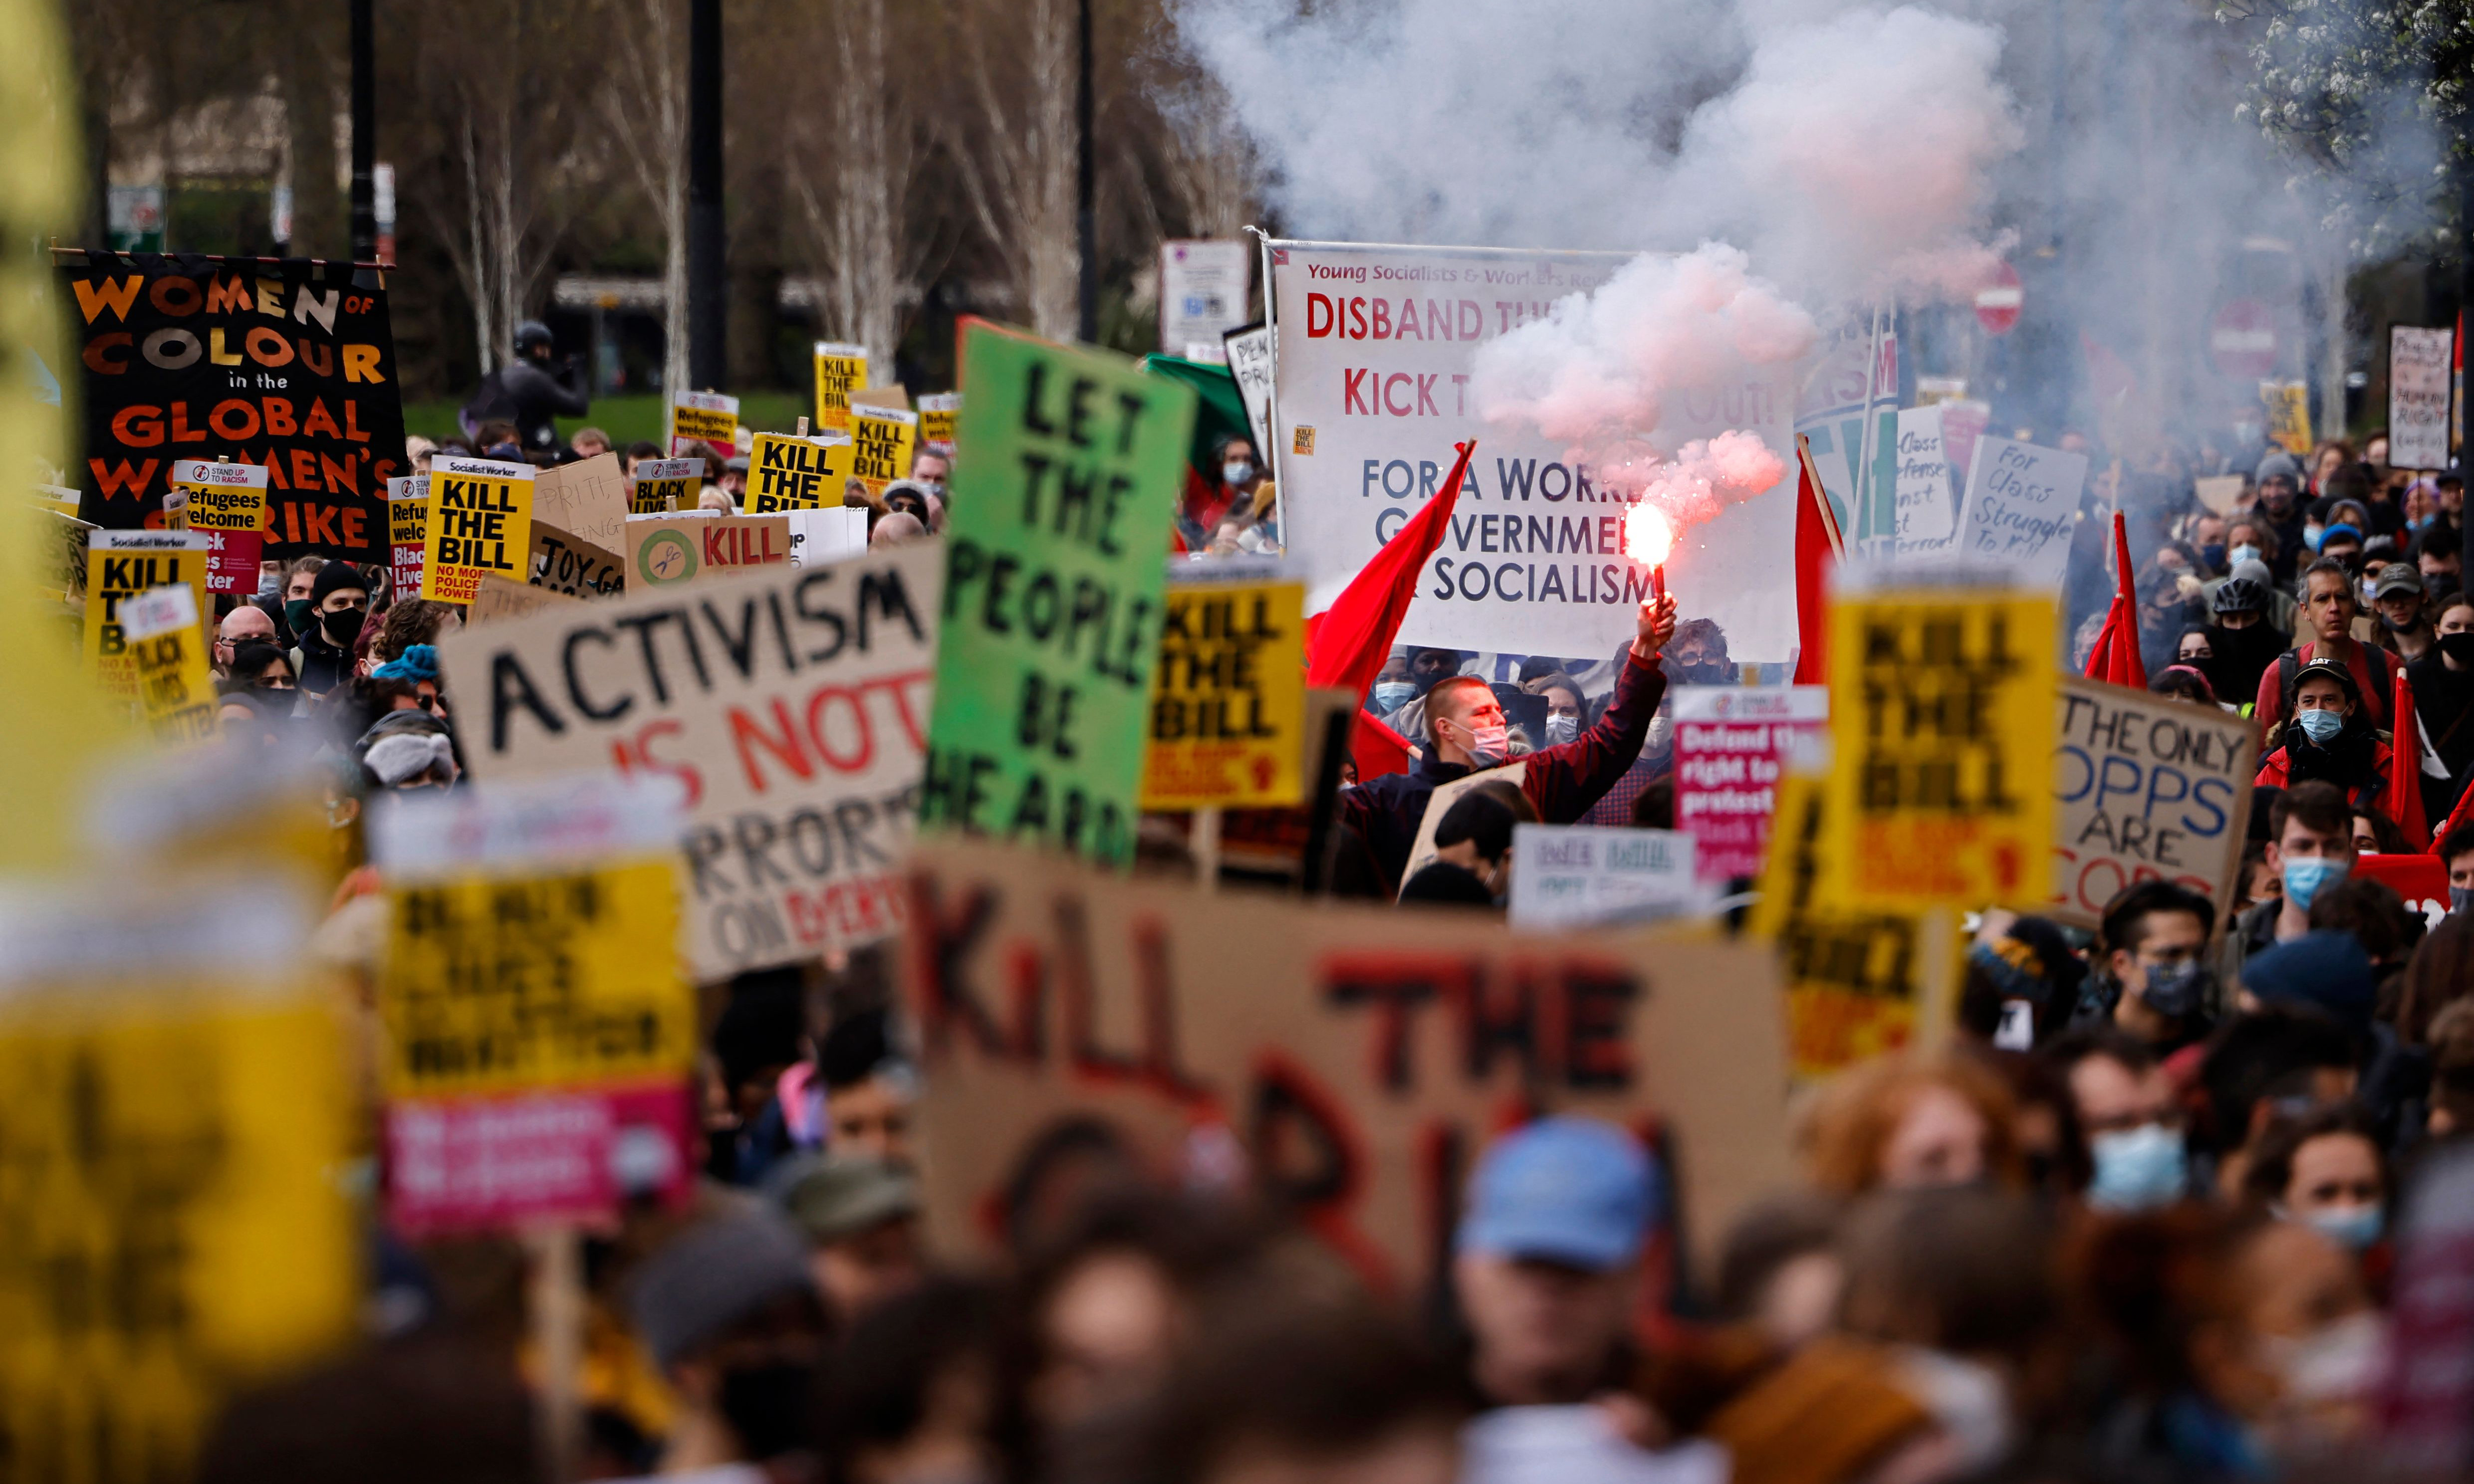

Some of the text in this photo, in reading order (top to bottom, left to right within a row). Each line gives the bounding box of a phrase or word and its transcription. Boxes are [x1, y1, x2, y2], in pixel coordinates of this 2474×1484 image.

[1307, 264, 1367, 283] Young
[1373, 265, 1458, 282] Socialists
[1464, 268, 1479, 282] &
[1485, 269, 1564, 286] Workers
[72, 269, 373, 336] WOMEN OF
[1307, 292, 1484, 341] DISBAND
[82, 327, 386, 384] COLOUR
[824, 360, 859, 375] KILL
[229, 371, 288, 390] in the
[825, 377, 854, 392] THE
[1344, 368, 1440, 417] KICK
[1683, 382, 1774, 425] OUT!
[825, 393, 848, 408] BIL
[1023, 360, 1150, 455] LET
[111, 396, 371, 448] GLOBAL
[678, 409, 732, 429] Refugees
[678, 425, 730, 440] welcome
[859, 421, 904, 444] KILL
[763, 441, 833, 476] KILL
[854, 456, 897, 478] BILL
[856, 439, 896, 462] THE
[1998, 445, 2039, 471] For
[89, 447, 398, 502] WMEN'S
[450, 462, 517, 476] Socialist Worker
[759, 467, 821, 501] THE
[1363, 459, 1439, 499] FOR
[1897, 457, 1946, 479] efense
[443, 480, 517, 513] KILL
[541, 476, 610, 514] PRITI,
[637, 480, 687, 499] BLACK
[1988, 468, 2054, 503] Class
[187, 507, 255, 528] elcome
[635, 500, 667, 514] LIVE
[1019, 452, 1134, 558] THE
[1975, 496, 2072, 547] Struggle
[144, 501, 369, 549] RIKE
[393, 523, 425, 541] welc
[440, 508, 505, 540] THE
[1376, 507, 1628, 555] GVERNME
[1975, 529, 1996, 552] To
[110, 536, 188, 548] Socialist Worker
[394, 547, 425, 566] Blac
[437, 537, 513, 570] BILL
[704, 526, 782, 566] KILL
[395, 568, 422, 585] Live
[437, 566, 455, 576] NO
[536, 536, 595, 588] JOY
[435, 587, 478, 600] POWER
[1433, 557, 1655, 605] SOCIALISM
[946, 539, 1150, 689] PEOPLE
[1167, 595, 1281, 639] KILL
[491, 566, 926, 753] ACTIVISM
[1160, 650, 1258, 689] THE
[2309, 657, 2330, 666] CAT
[726, 667, 935, 795] NOT
[1017, 670, 1078, 760] BE
[1155, 696, 1277, 738] BILL
[1680, 726, 1770, 751] Defend
[2062, 695, 2245, 775] THE ONLY
[1682, 757, 1778, 788] right to
[1682, 790, 1774, 817] protest
[2049, 746, 2233, 838] OPPS
[2077, 808, 2185, 867] ARE
[902, 861, 1646, 1107] KILL THE
